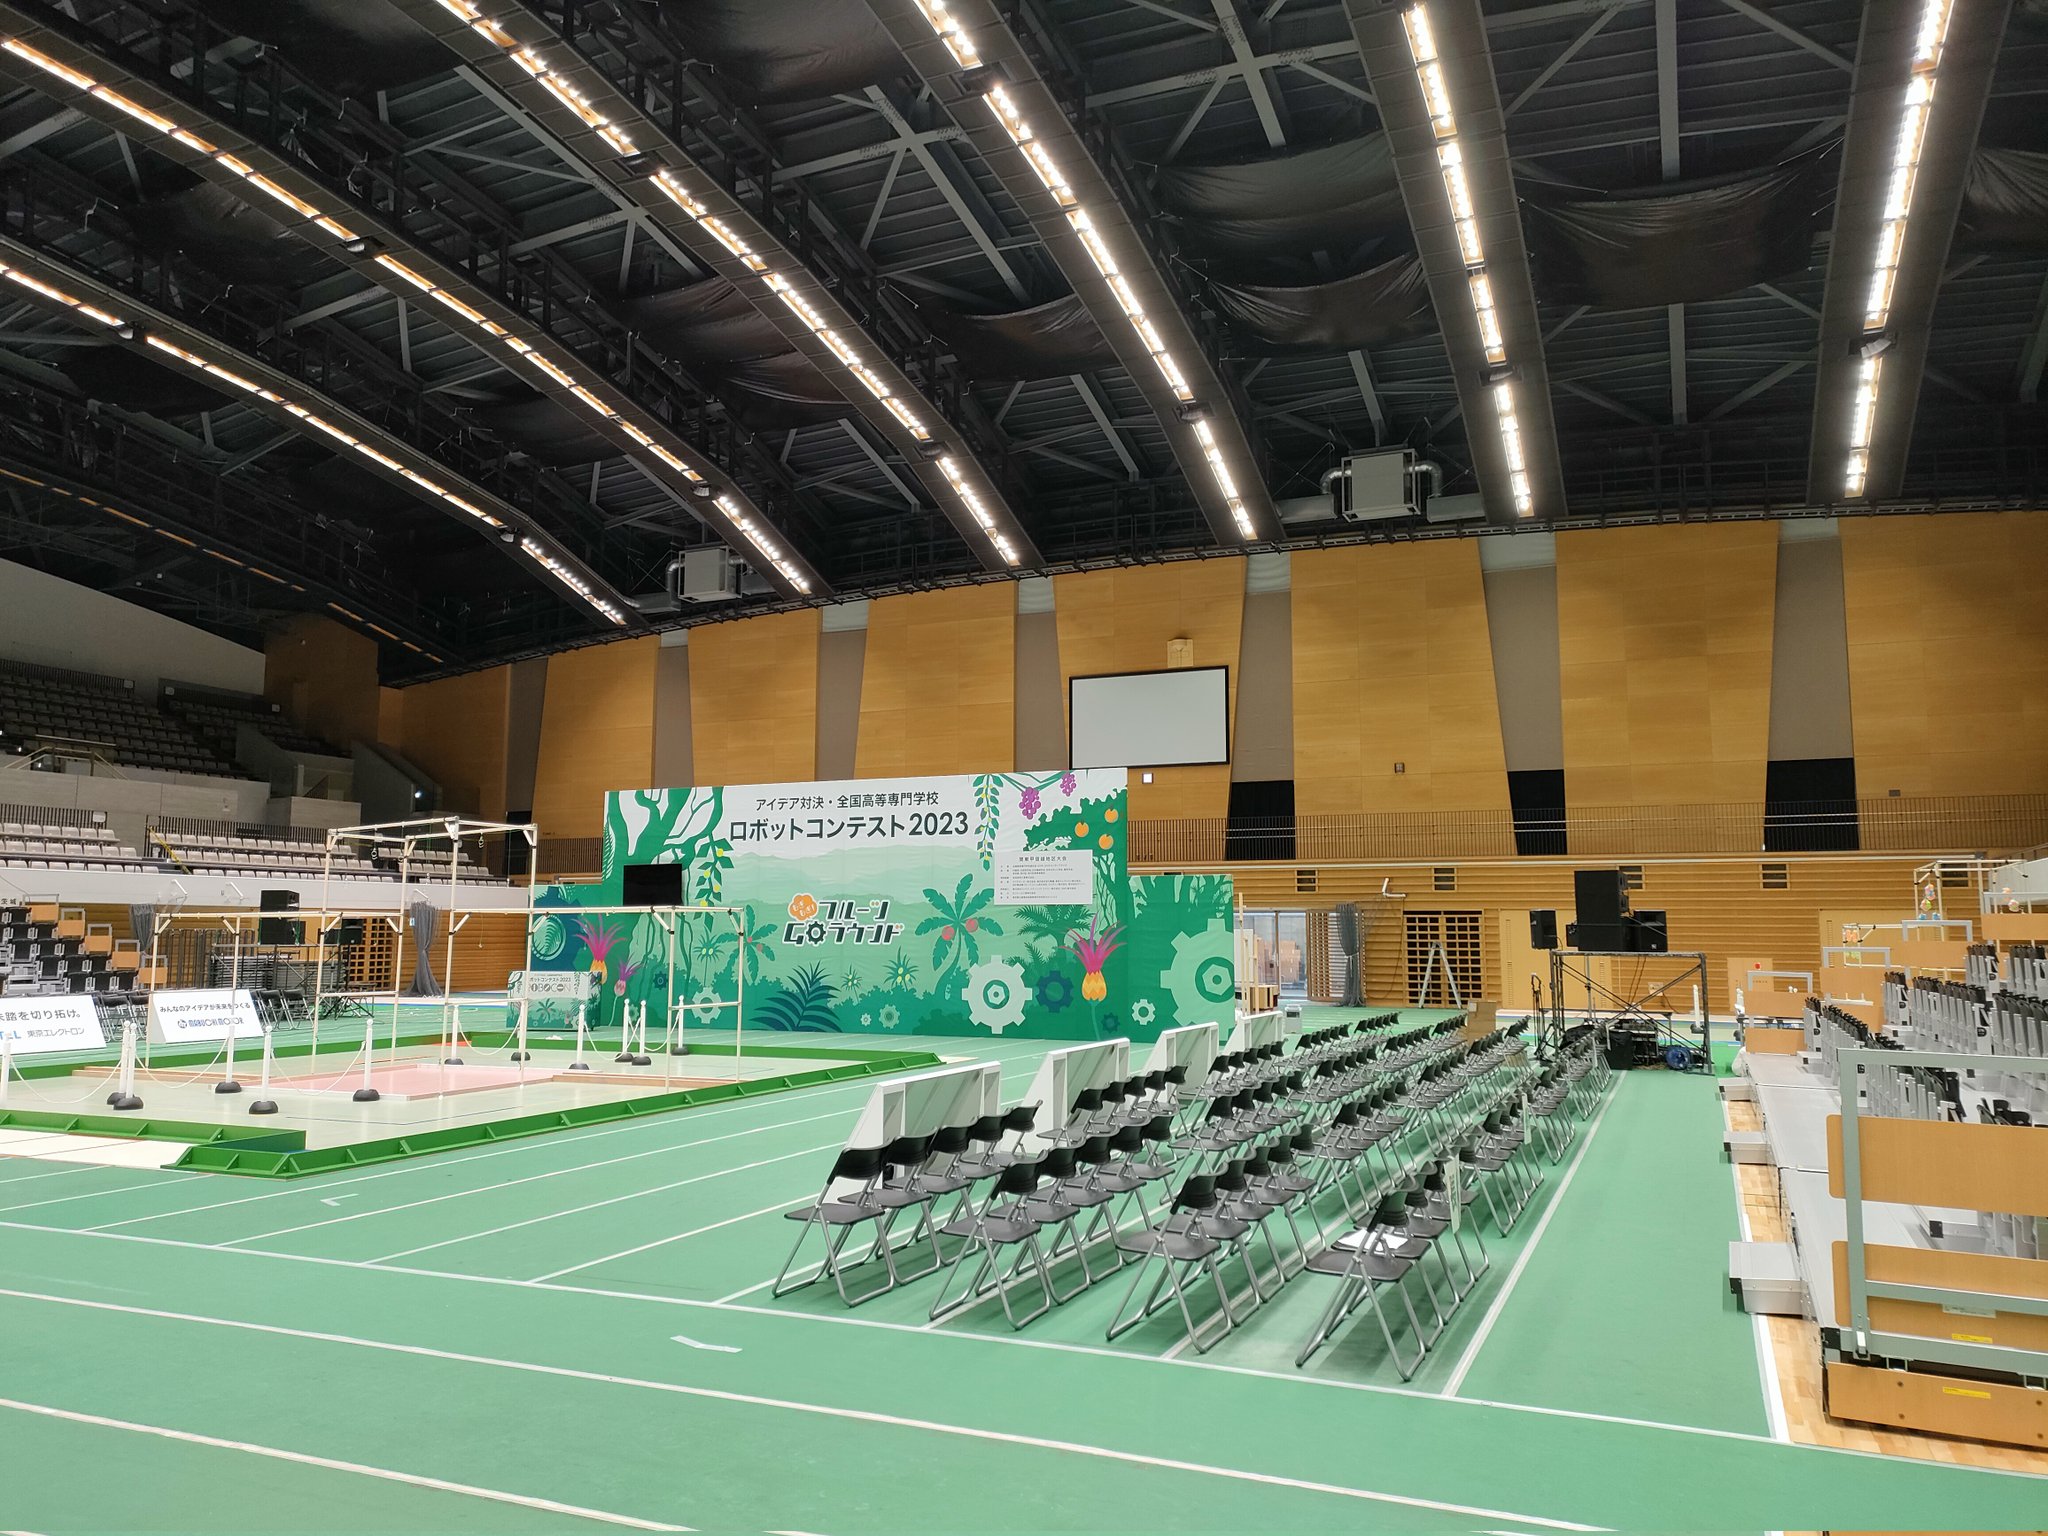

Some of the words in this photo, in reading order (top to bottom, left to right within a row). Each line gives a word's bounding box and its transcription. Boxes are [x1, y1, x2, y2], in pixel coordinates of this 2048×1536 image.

[756, 791, 939, 811] アイデア対決・全国高等専門学校
[730, 811, 969, 841] ロボットコンテスト2023
[27, 1027, 85, 1038] 東京エレクトロン
